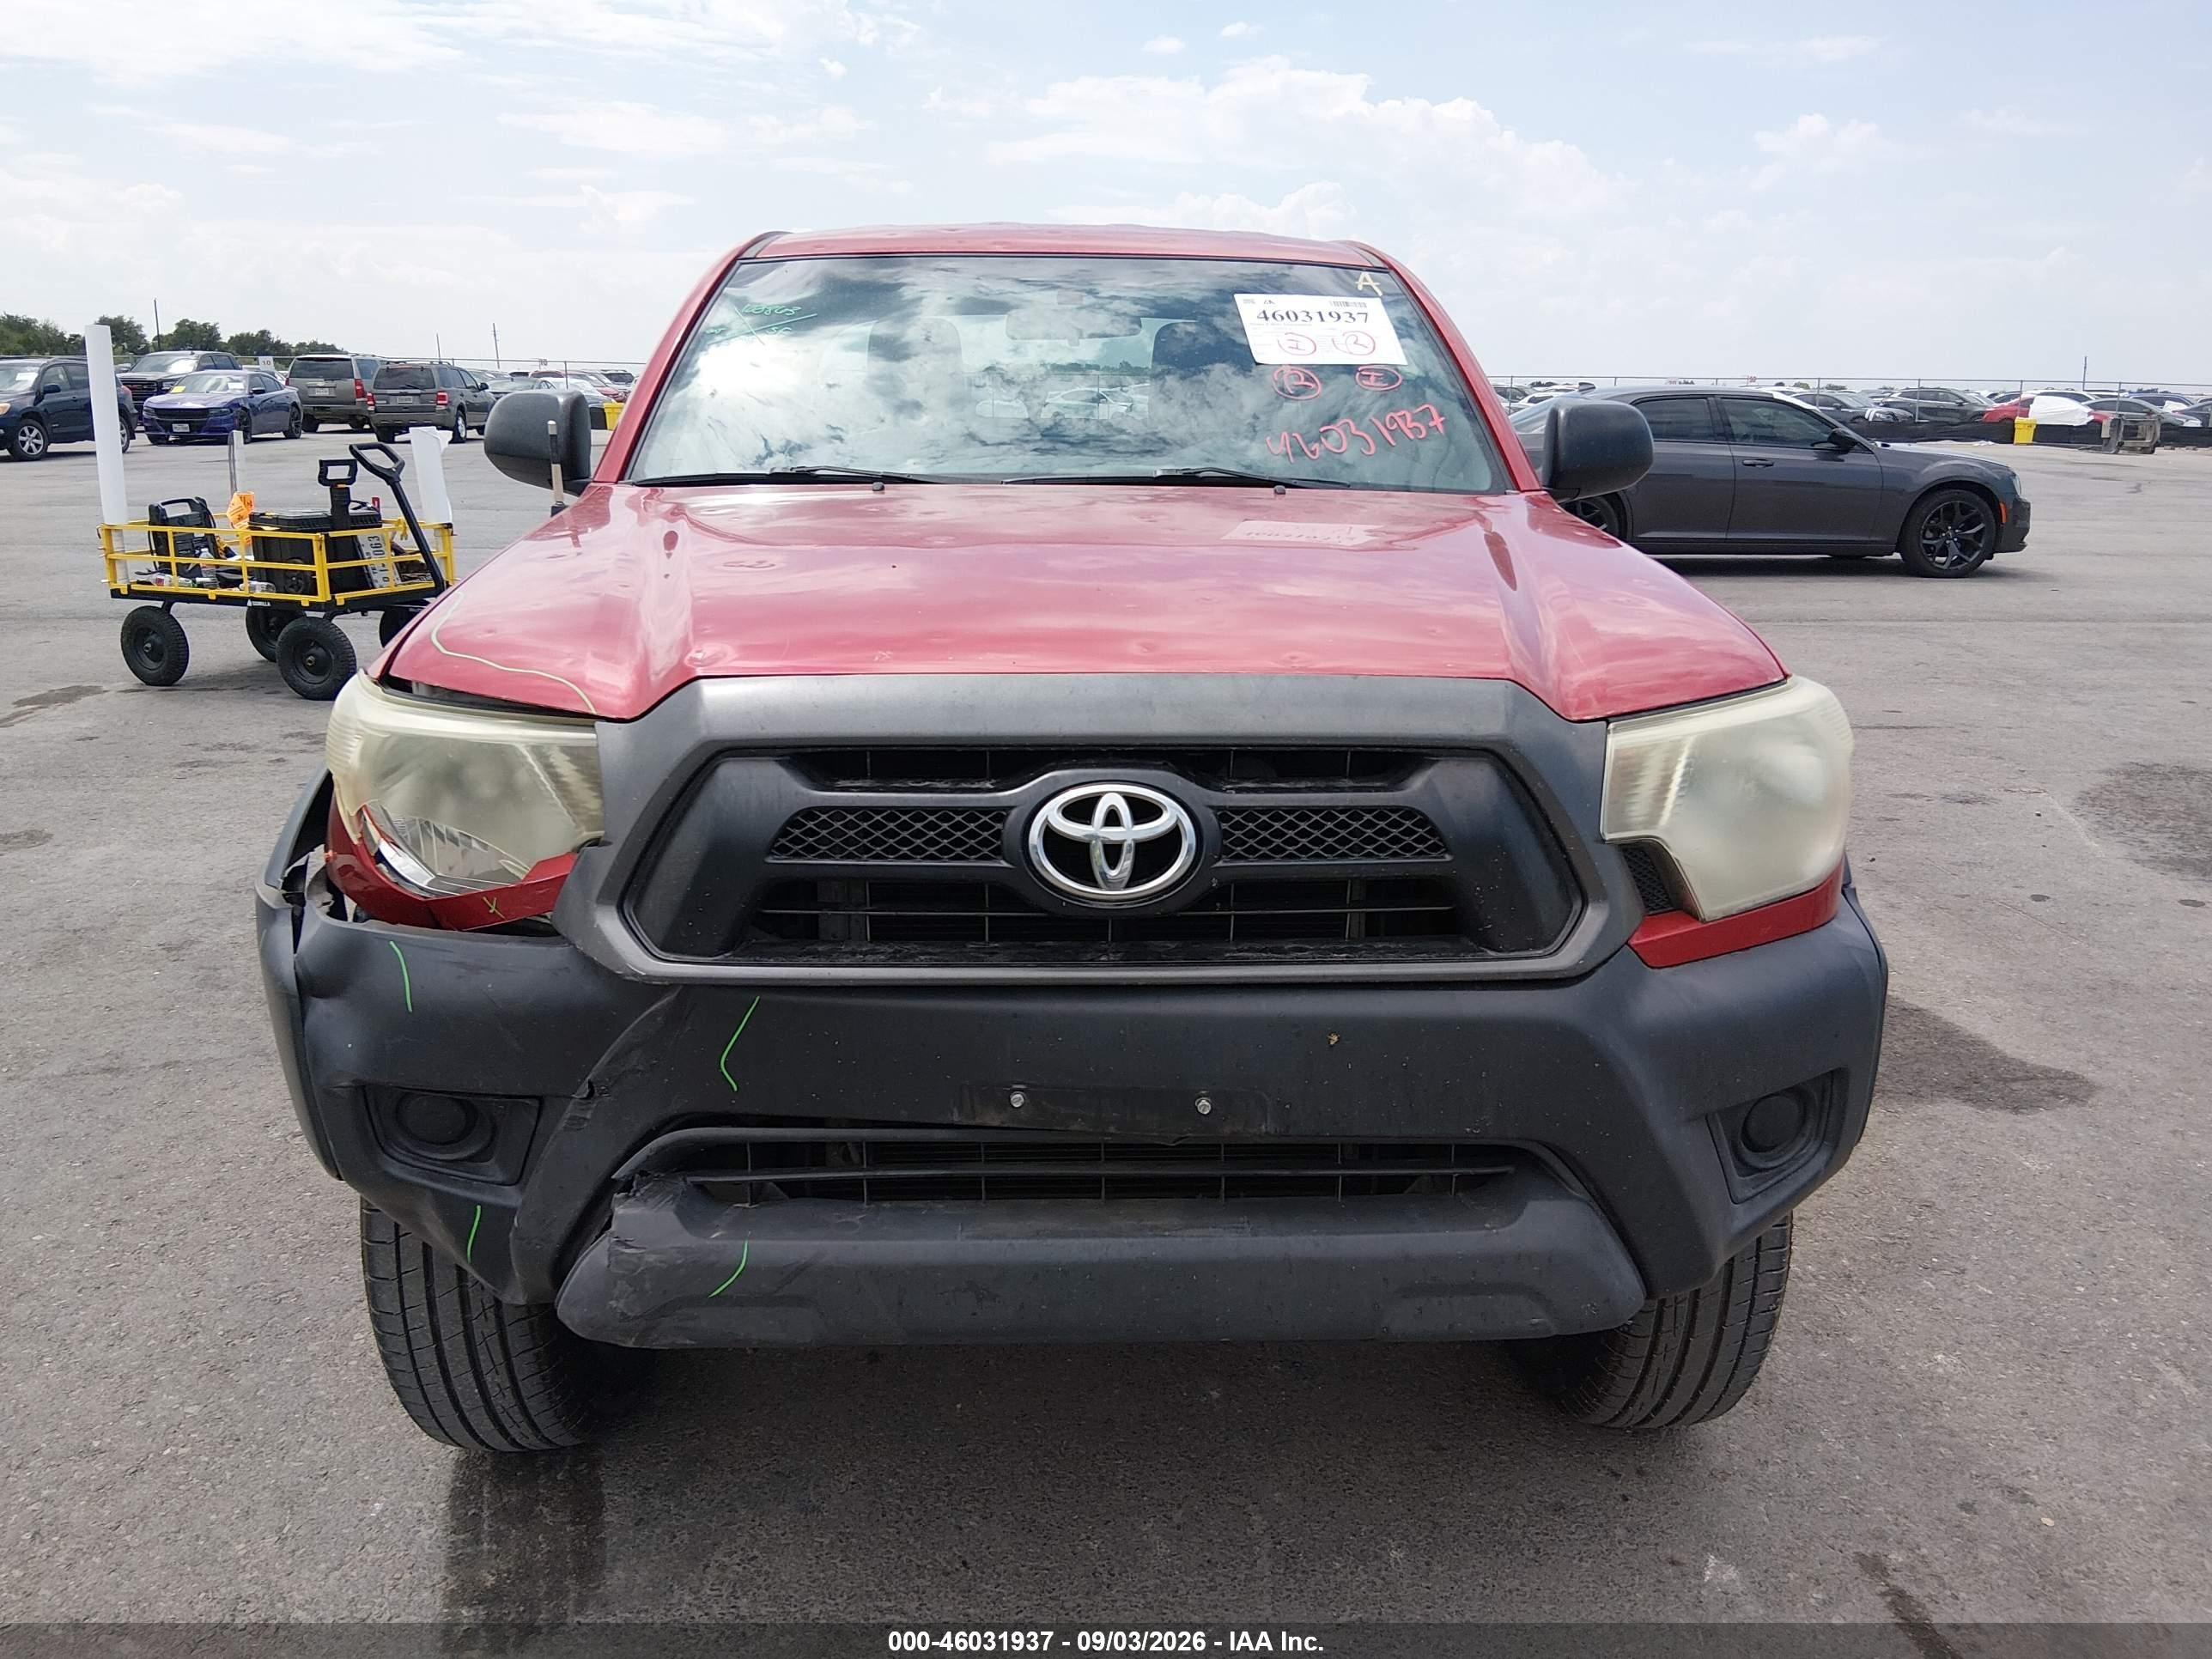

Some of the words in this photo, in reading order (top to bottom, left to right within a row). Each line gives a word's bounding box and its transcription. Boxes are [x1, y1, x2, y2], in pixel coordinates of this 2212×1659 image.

[1355, 271, 1382, 296] A
[1257, 308, 1370, 324] 46031937
[1266, 404, 1446, 464] 46031937
